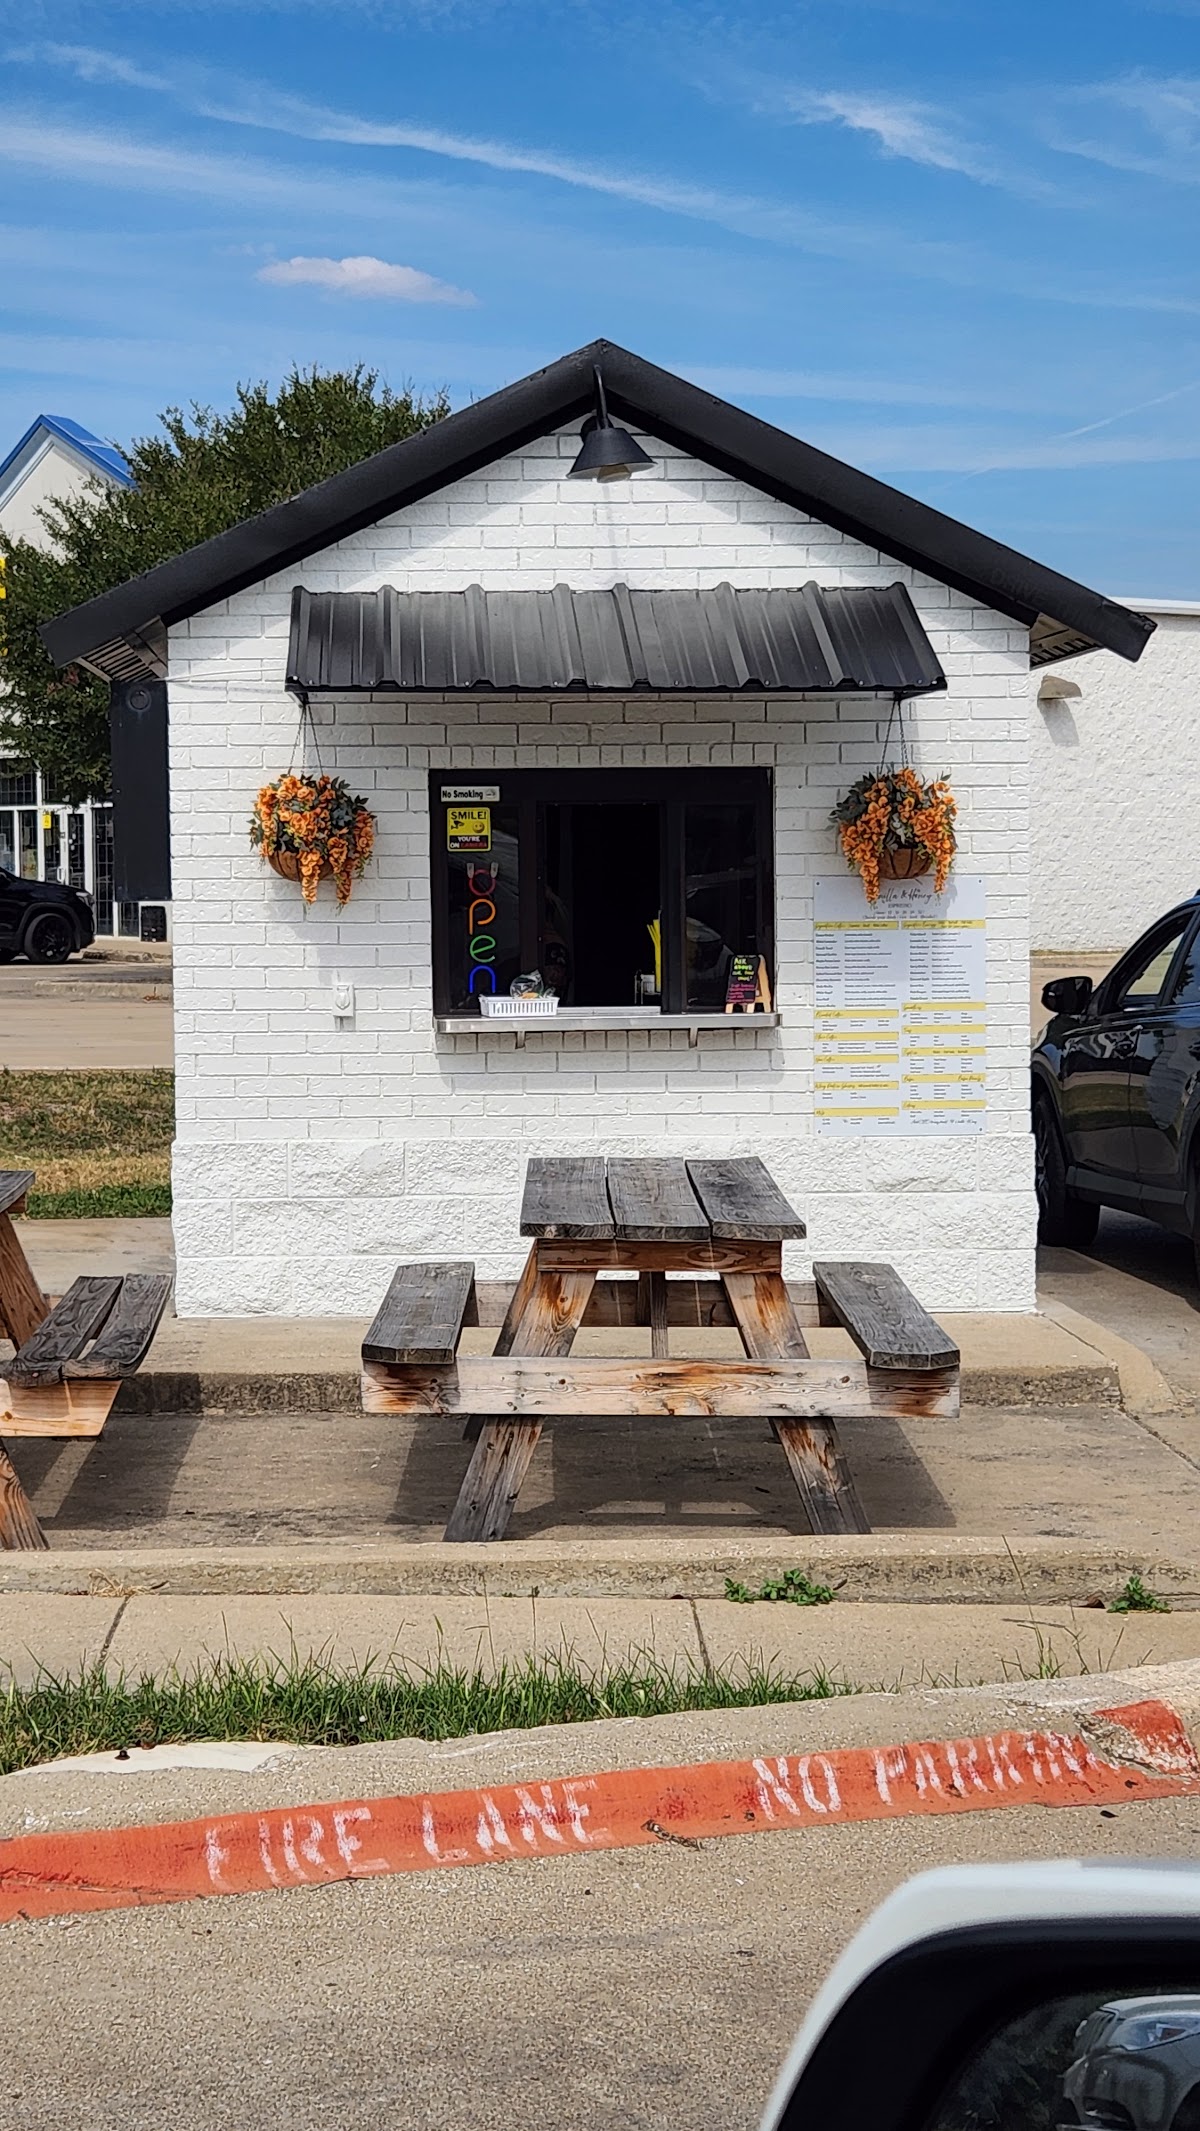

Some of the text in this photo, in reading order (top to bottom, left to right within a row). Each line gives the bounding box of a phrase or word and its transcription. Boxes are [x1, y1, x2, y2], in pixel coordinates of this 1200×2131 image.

[442, 790, 484, 800] No Smoking
[450, 811, 487, 820] SMILE!
[206, 1807, 390, 1891] FIRE
[422, 1778, 610, 1863] LANE
[752, 1756, 842, 1821] NO
